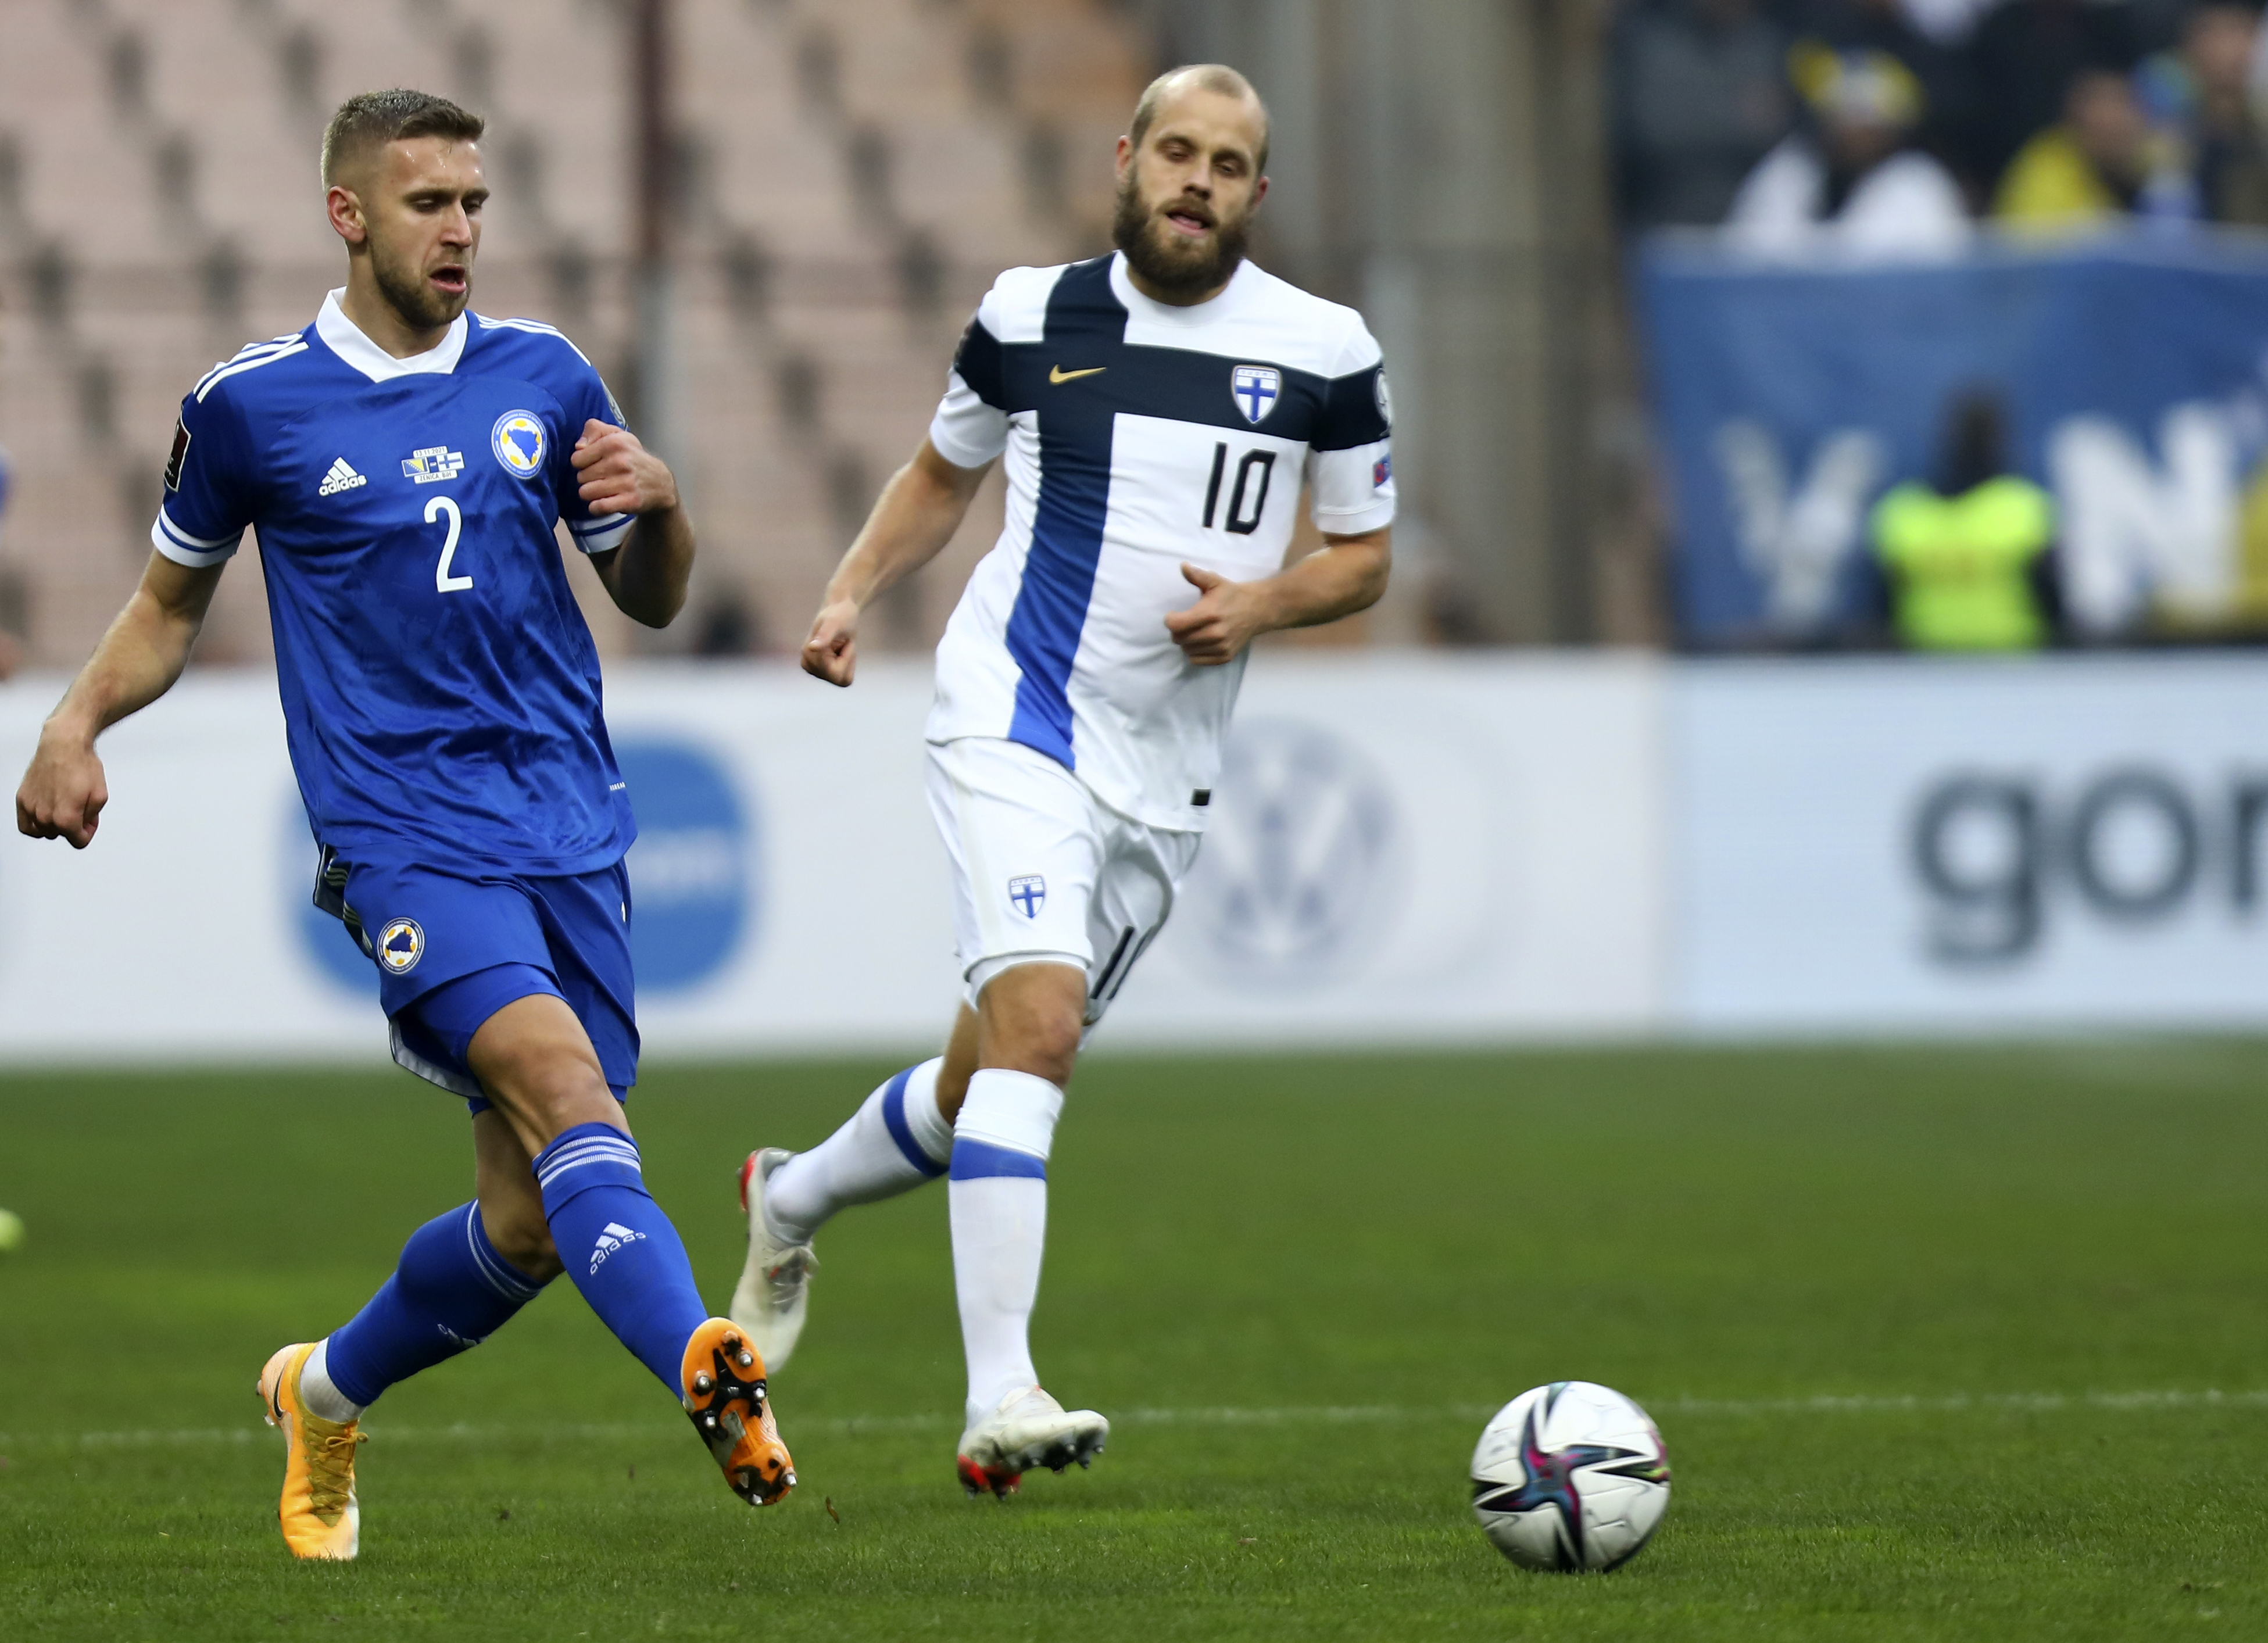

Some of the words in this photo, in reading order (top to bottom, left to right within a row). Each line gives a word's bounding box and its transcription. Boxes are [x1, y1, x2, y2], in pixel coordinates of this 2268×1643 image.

[319, 475, 367, 497] adidas
[1203, 441, 1277, 535] 10
[424, 496, 474, 593] 2
[590, 1232, 646, 1275] adidas
